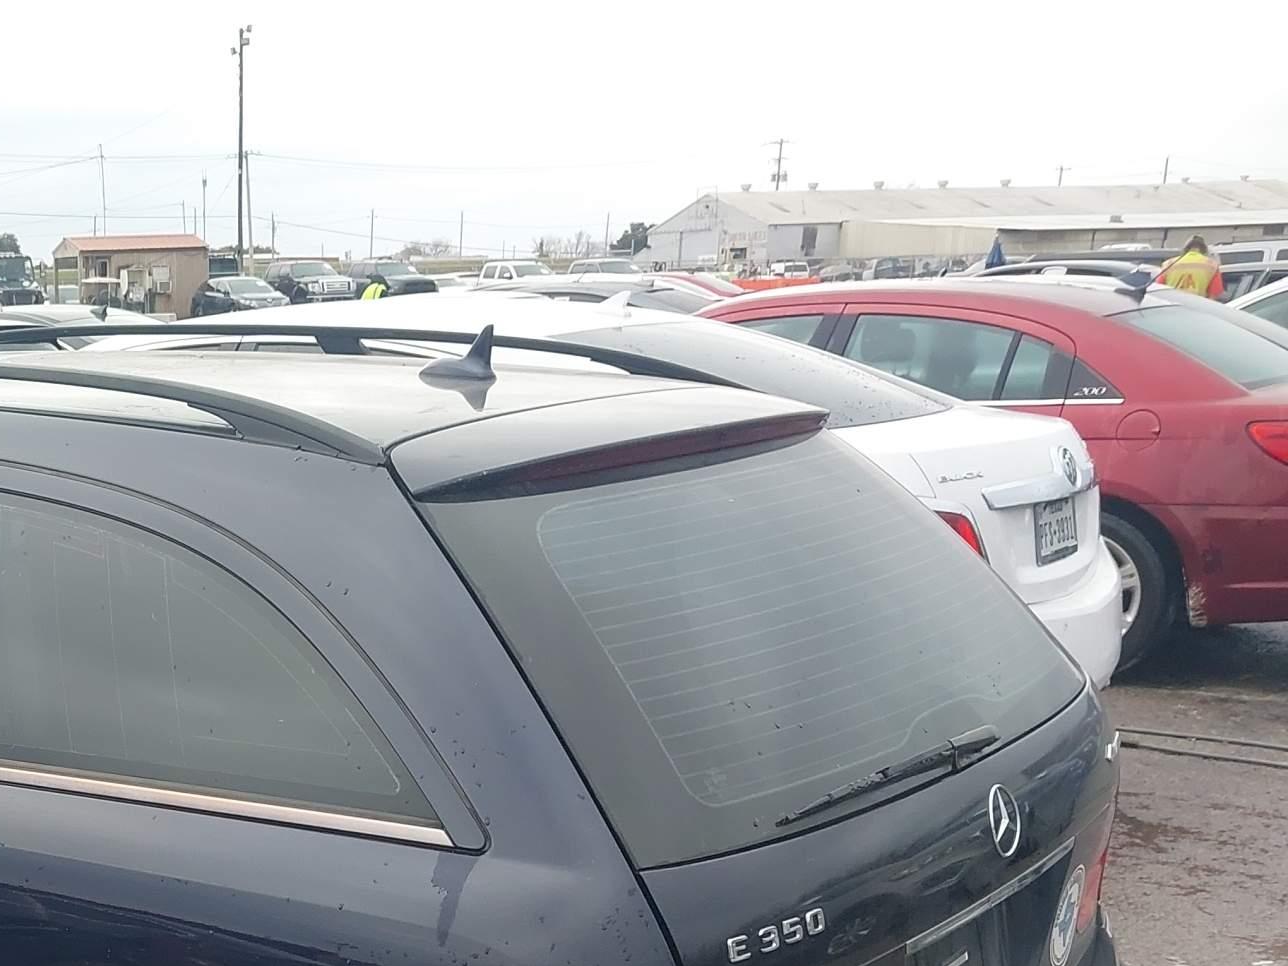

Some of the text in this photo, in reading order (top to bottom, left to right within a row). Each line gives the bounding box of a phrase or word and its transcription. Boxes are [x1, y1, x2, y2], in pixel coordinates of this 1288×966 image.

[1073, 386, 1107, 396] 200
[937, 471, 984, 483] BUICK
[727, 907, 826, 963] E 350
